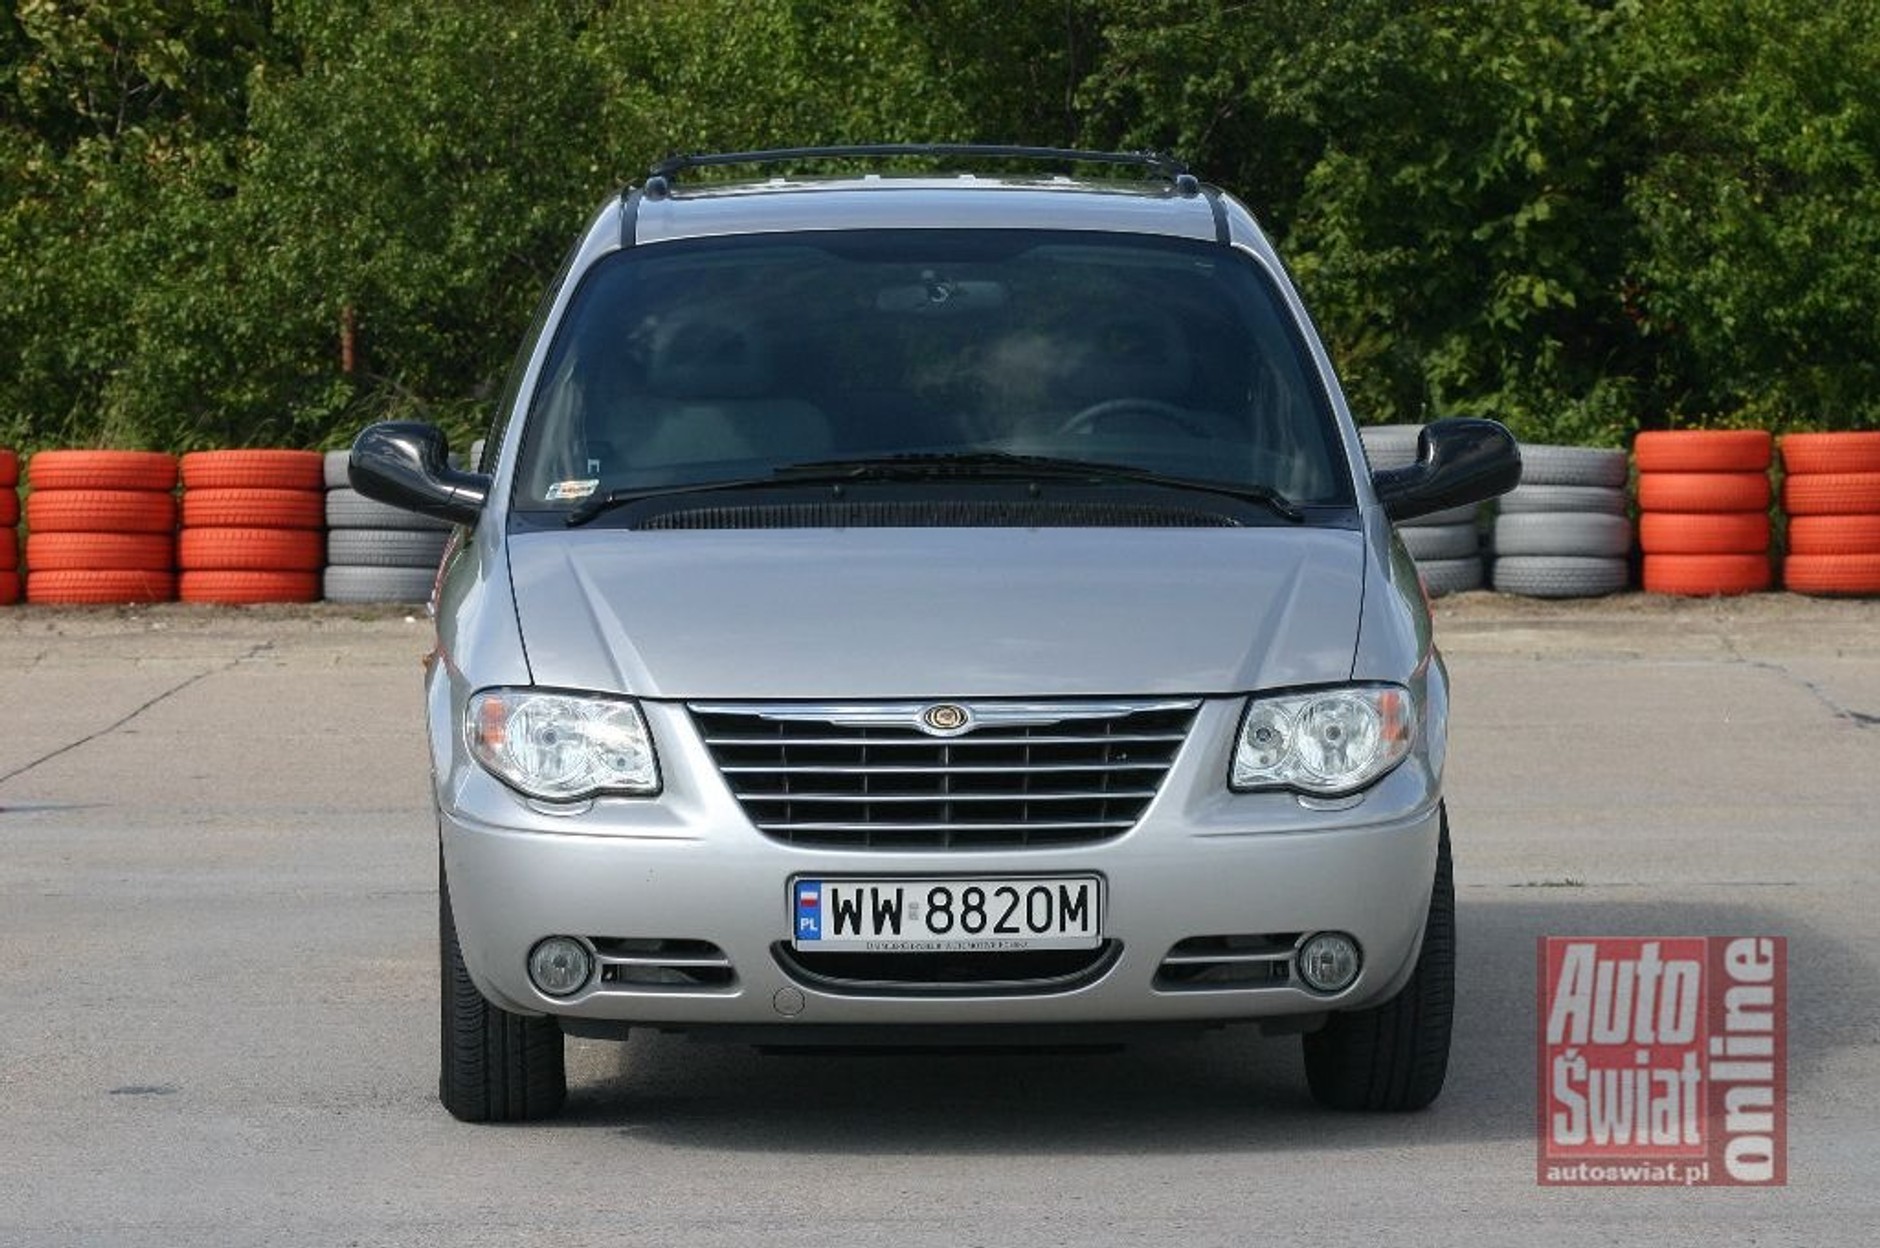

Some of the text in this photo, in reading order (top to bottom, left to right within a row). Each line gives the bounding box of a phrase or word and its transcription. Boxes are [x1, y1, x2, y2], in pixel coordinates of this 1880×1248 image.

[800, 917, 818, 931] PL
[832, 885, 1089, 935] WW 8820M
